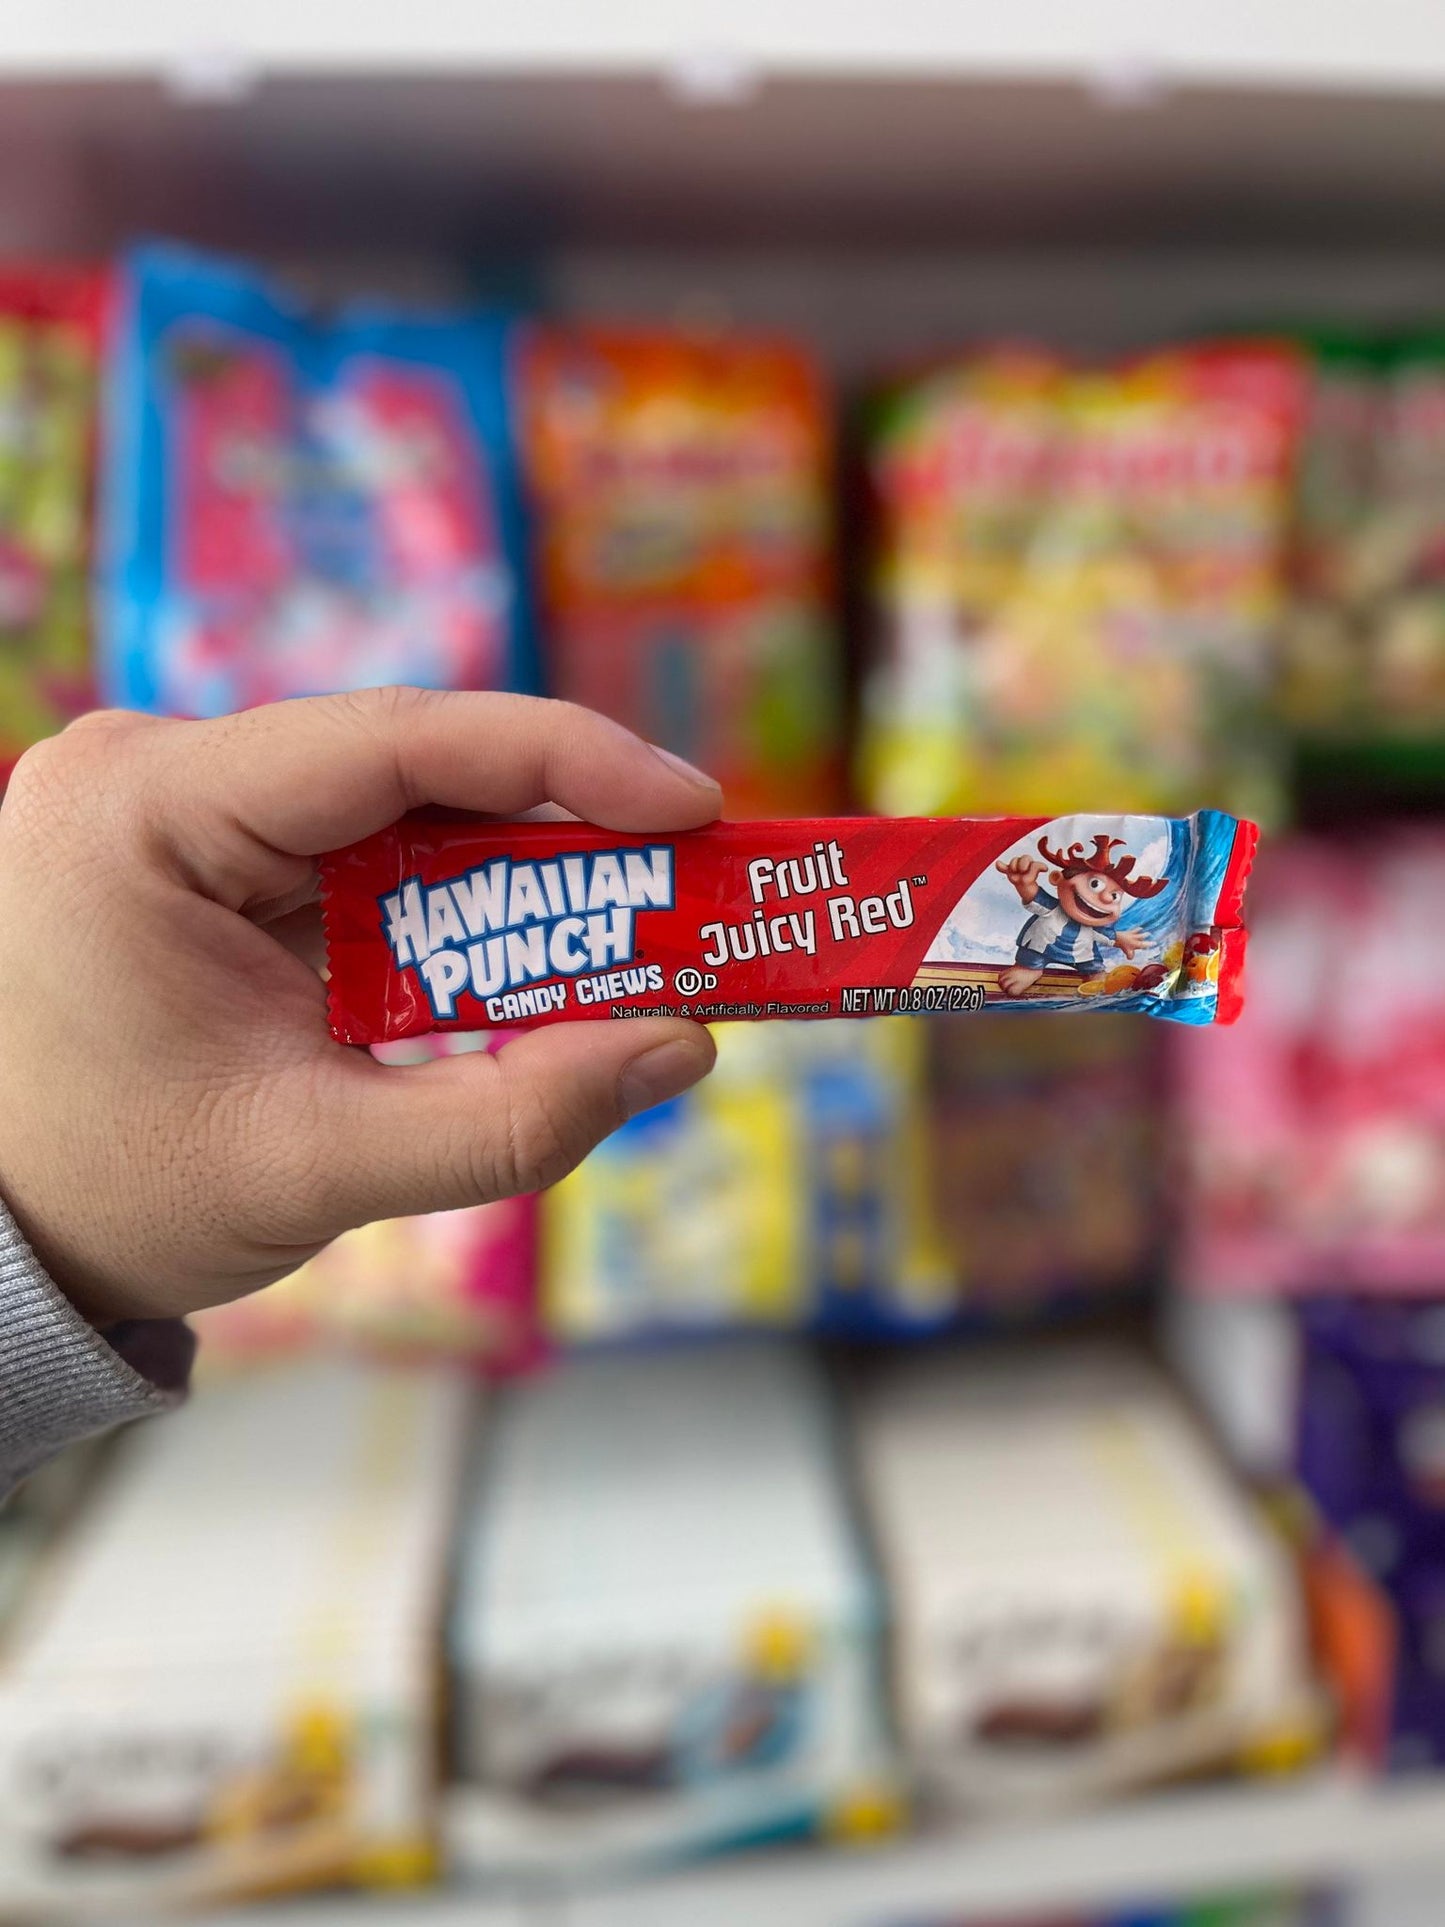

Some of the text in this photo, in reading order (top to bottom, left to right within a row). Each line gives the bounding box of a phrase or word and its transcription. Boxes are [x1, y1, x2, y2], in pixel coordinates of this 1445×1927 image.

[748, 839, 849, 904] Fruit
[381, 846, 673, 968] HAWAIIAN
[421, 905, 635, 1019] PUNCH
[700, 909, 817, 967] Juicy
[486, 964, 664, 1022] CANDY CHEWS
[611, 1002, 829, 1018] Naturally & Artificially Flavored
[842, 986, 985, 1012] NET WT 0.8 OZ (22g)
